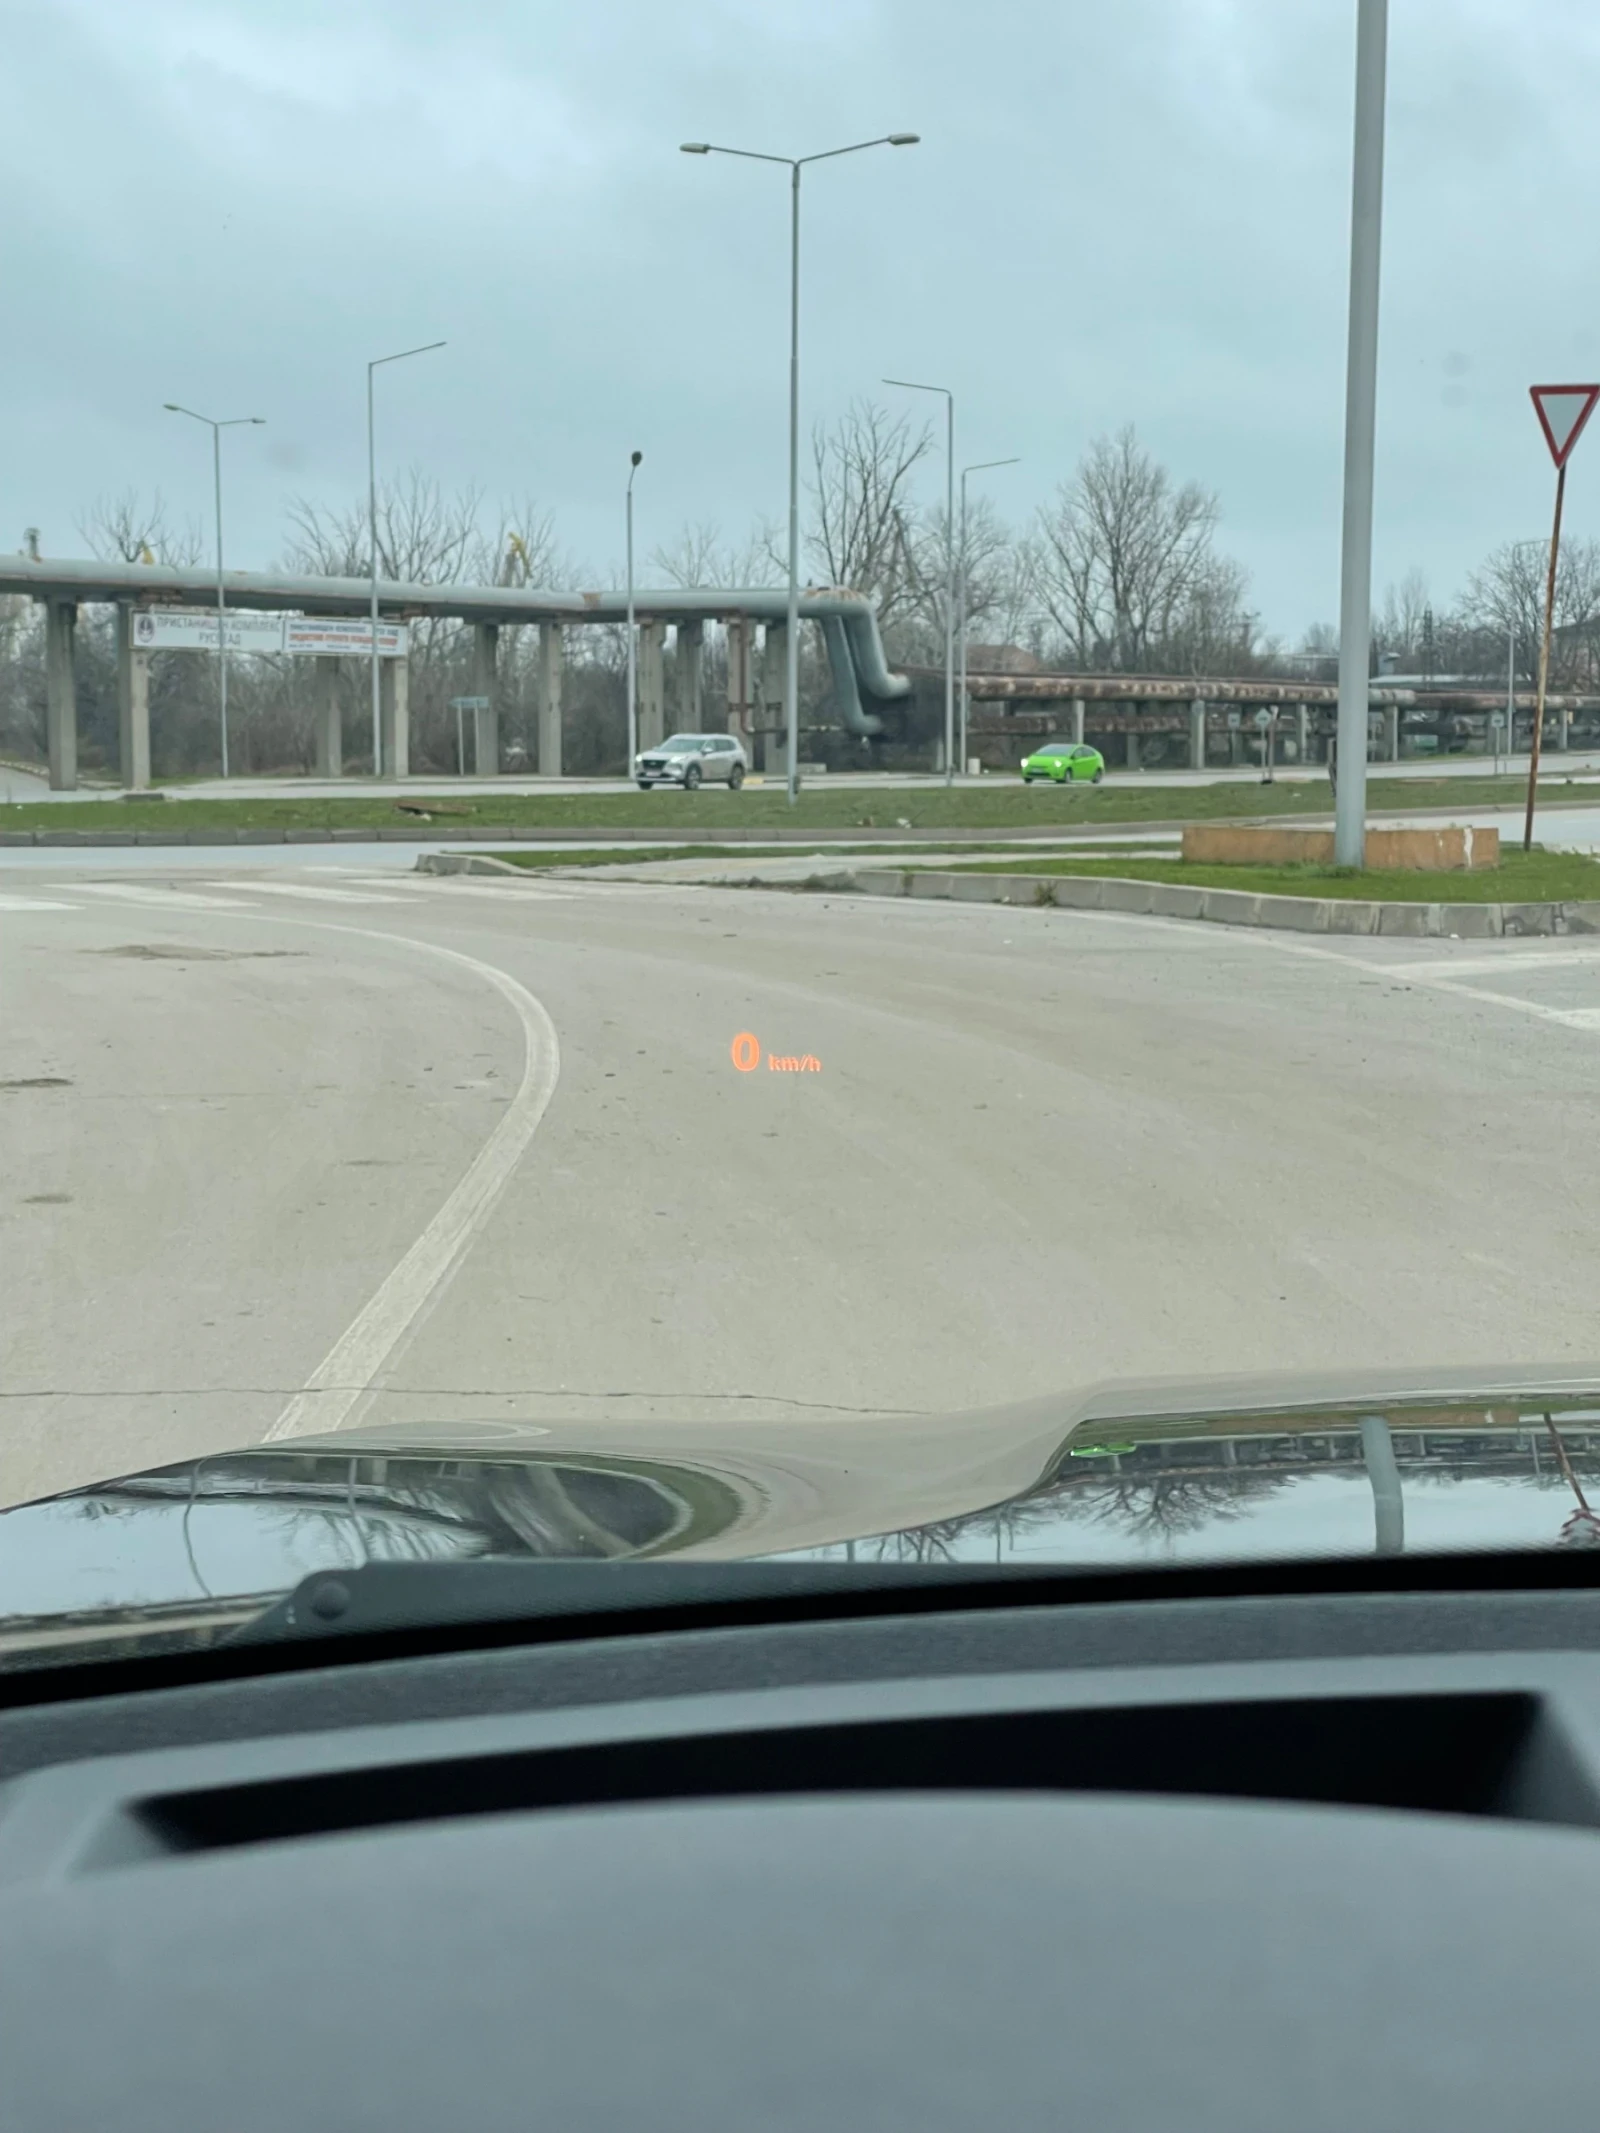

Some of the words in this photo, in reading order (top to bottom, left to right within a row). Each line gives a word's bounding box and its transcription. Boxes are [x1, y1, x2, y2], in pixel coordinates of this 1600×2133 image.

[156, 616, 229, 630] ПРИСТАНИЩН
[730, 1032, 760, 1072] 0
[768, 1053, 822, 1072] km/h
